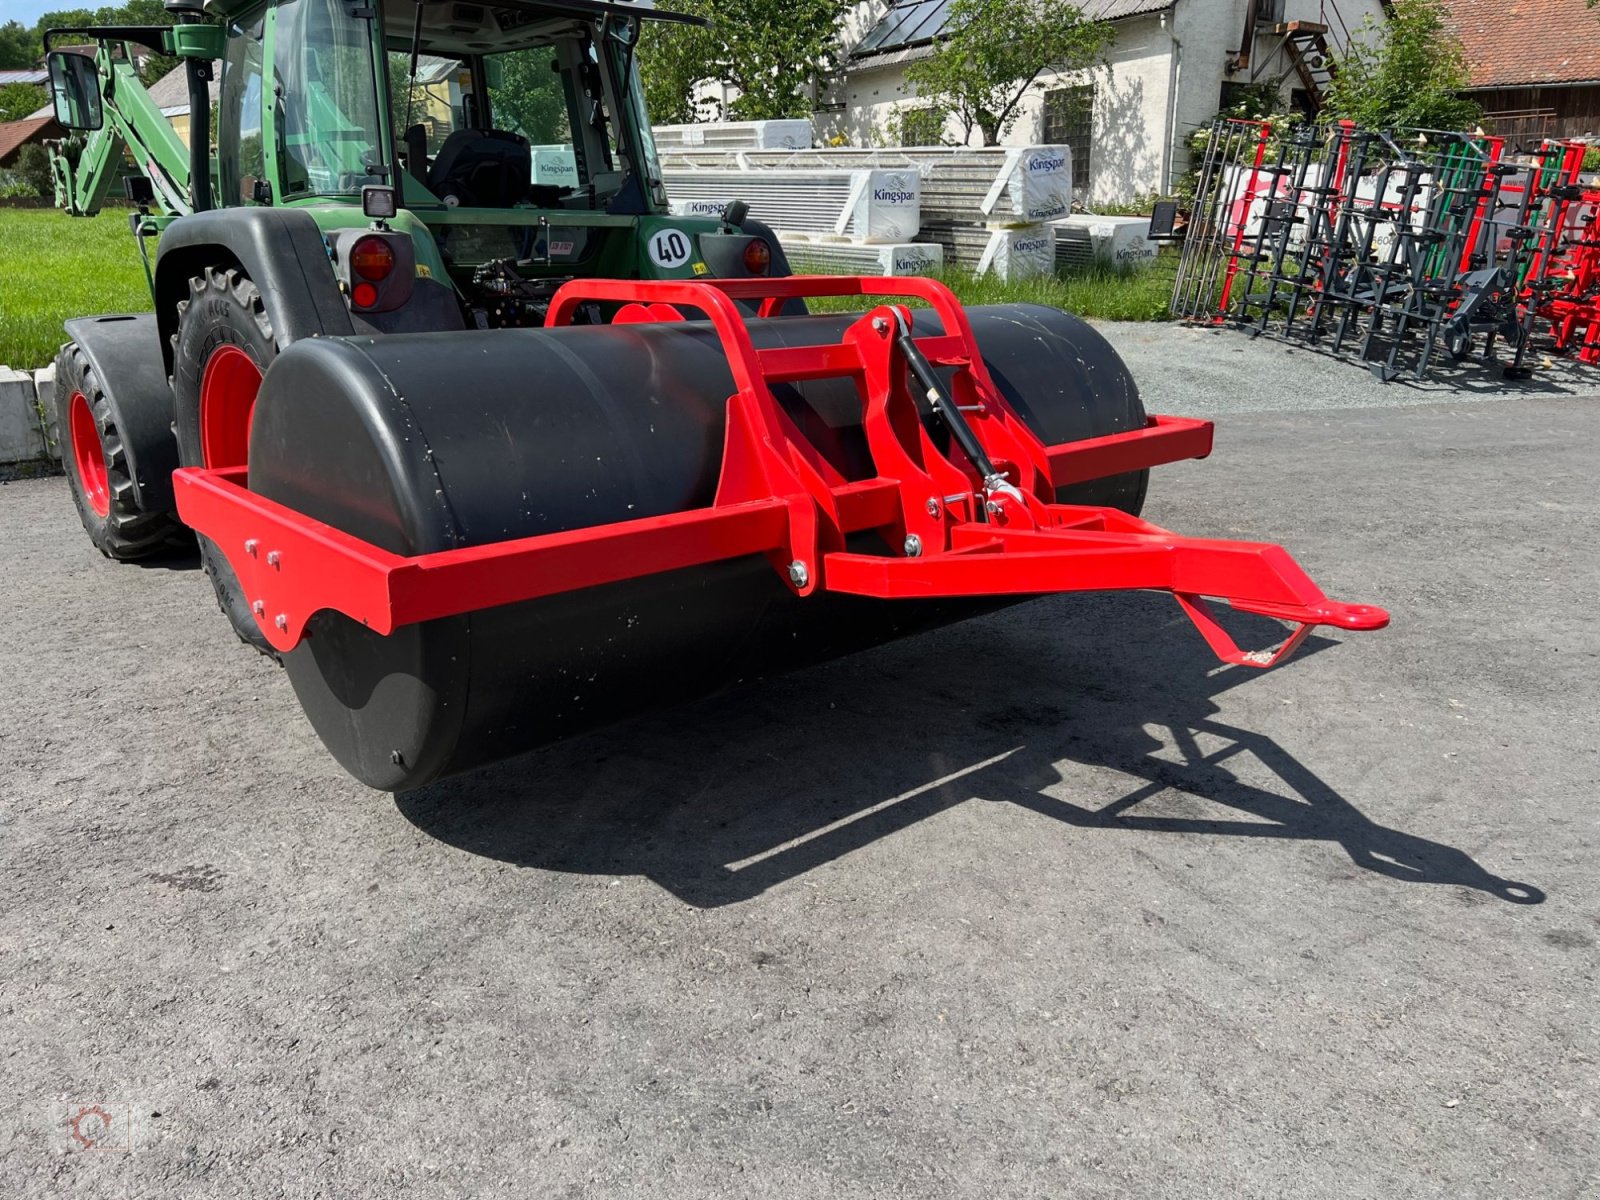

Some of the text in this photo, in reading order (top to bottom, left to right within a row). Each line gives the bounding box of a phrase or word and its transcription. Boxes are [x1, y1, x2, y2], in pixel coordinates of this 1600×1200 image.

[541, 164, 574, 174] Kingspan
[874, 189, 915, 204] Kingspan
[692, 202, 728, 214] Kingsp
[656, 233, 686, 262] 40
[1013, 239, 1048, 252] Kingspan
[1116, 248, 1153, 262] Kingspan
[896, 259, 936, 272] Kingspan
